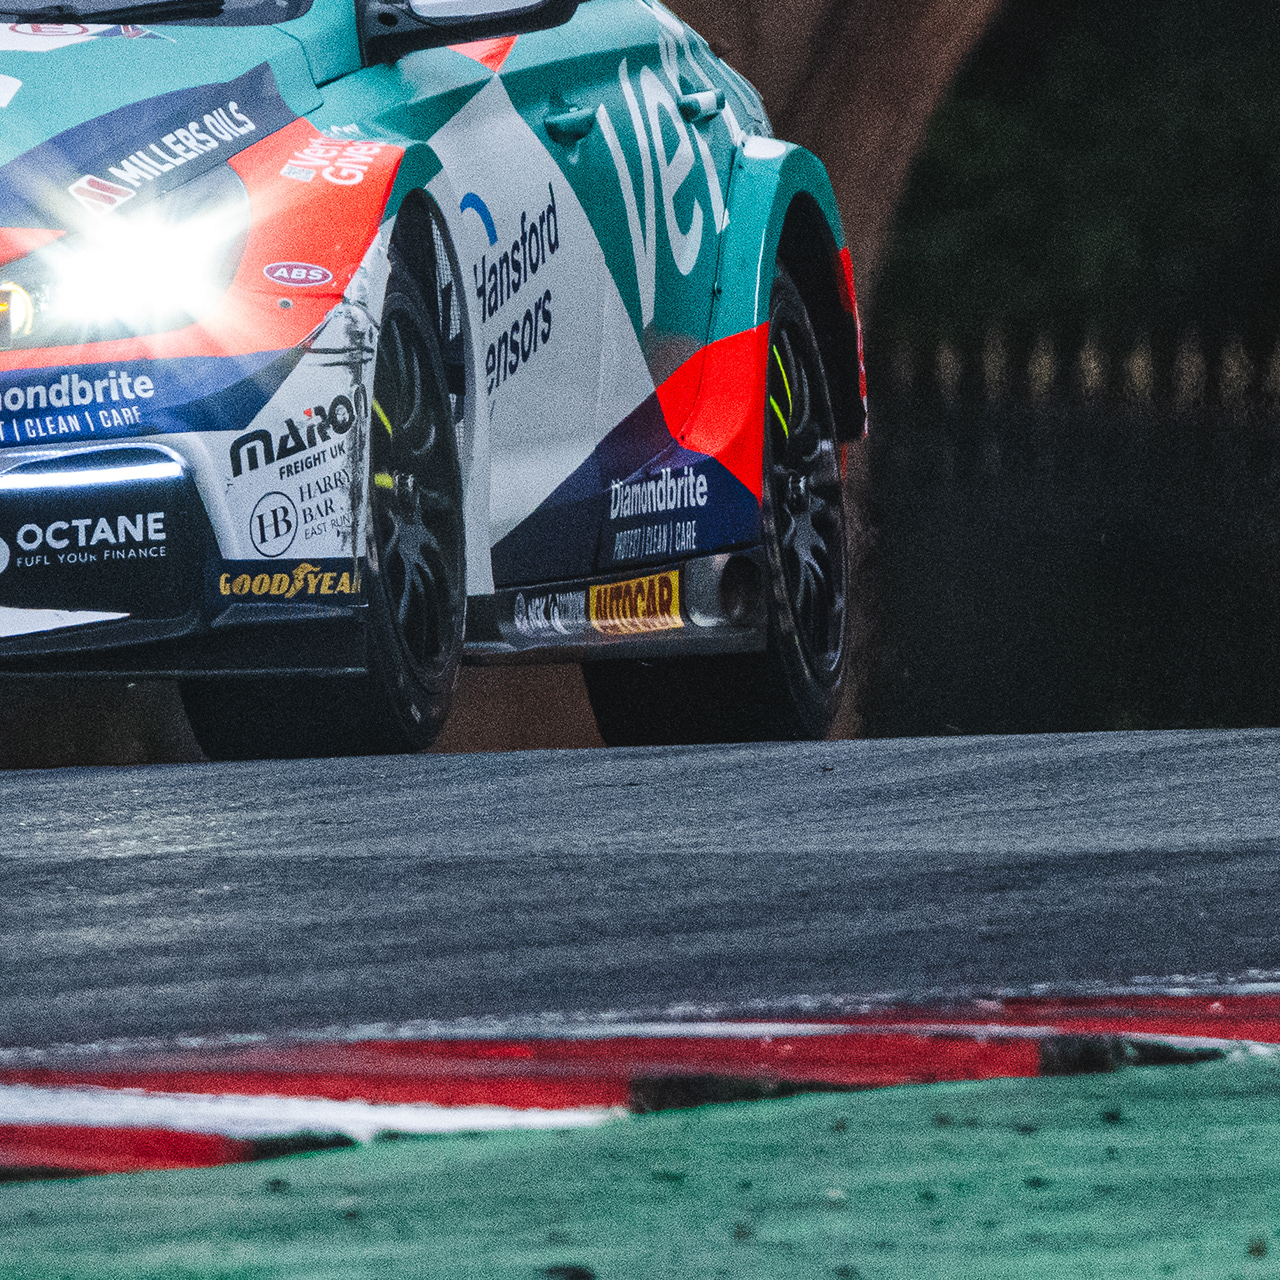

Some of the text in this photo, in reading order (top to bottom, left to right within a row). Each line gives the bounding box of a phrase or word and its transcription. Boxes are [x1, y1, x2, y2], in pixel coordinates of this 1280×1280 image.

[109, 101, 255, 187] MILLERS OILS
[274, 267, 323, 280] ABS
[485, 288, 552, 397] ensors
[25, 414, 81, 438] CLEAN
[101, 406, 141, 428] CARE
[278, 441, 346, 481] FREIGHT UK
[302, 497, 335, 525] BAR
[610, 467, 708, 520] Diamondbrite
[16, 511, 167, 552] OCTANE
[256, 505, 293, 545] HB
[304, 522, 328, 540] EAST
[675, 520, 697, 551] CARE
[17, 546, 167, 568] FUEL YOUR FINANCE
